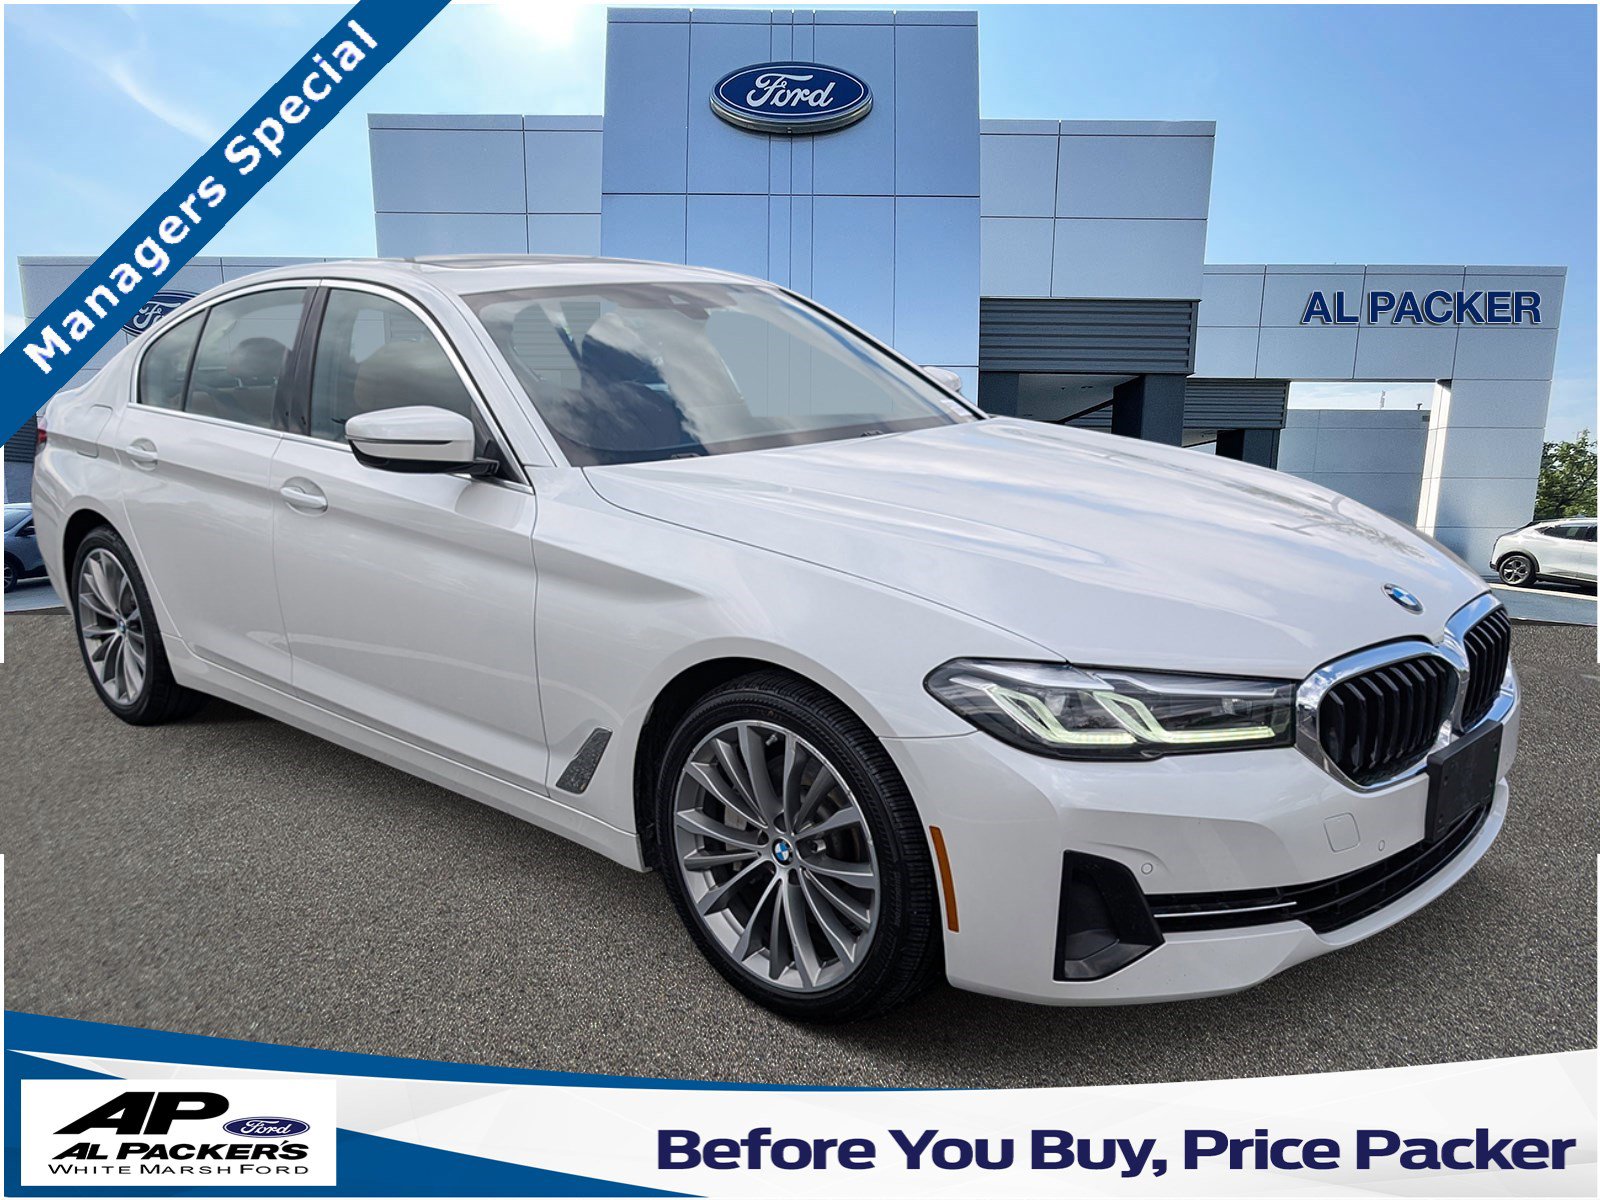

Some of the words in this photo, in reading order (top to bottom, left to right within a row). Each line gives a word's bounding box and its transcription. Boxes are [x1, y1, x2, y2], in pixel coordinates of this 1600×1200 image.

[746, 73, 835, 108] Ford
[1301, 290, 1360, 324] AL
[1368, 290, 1542, 324] PACKER
